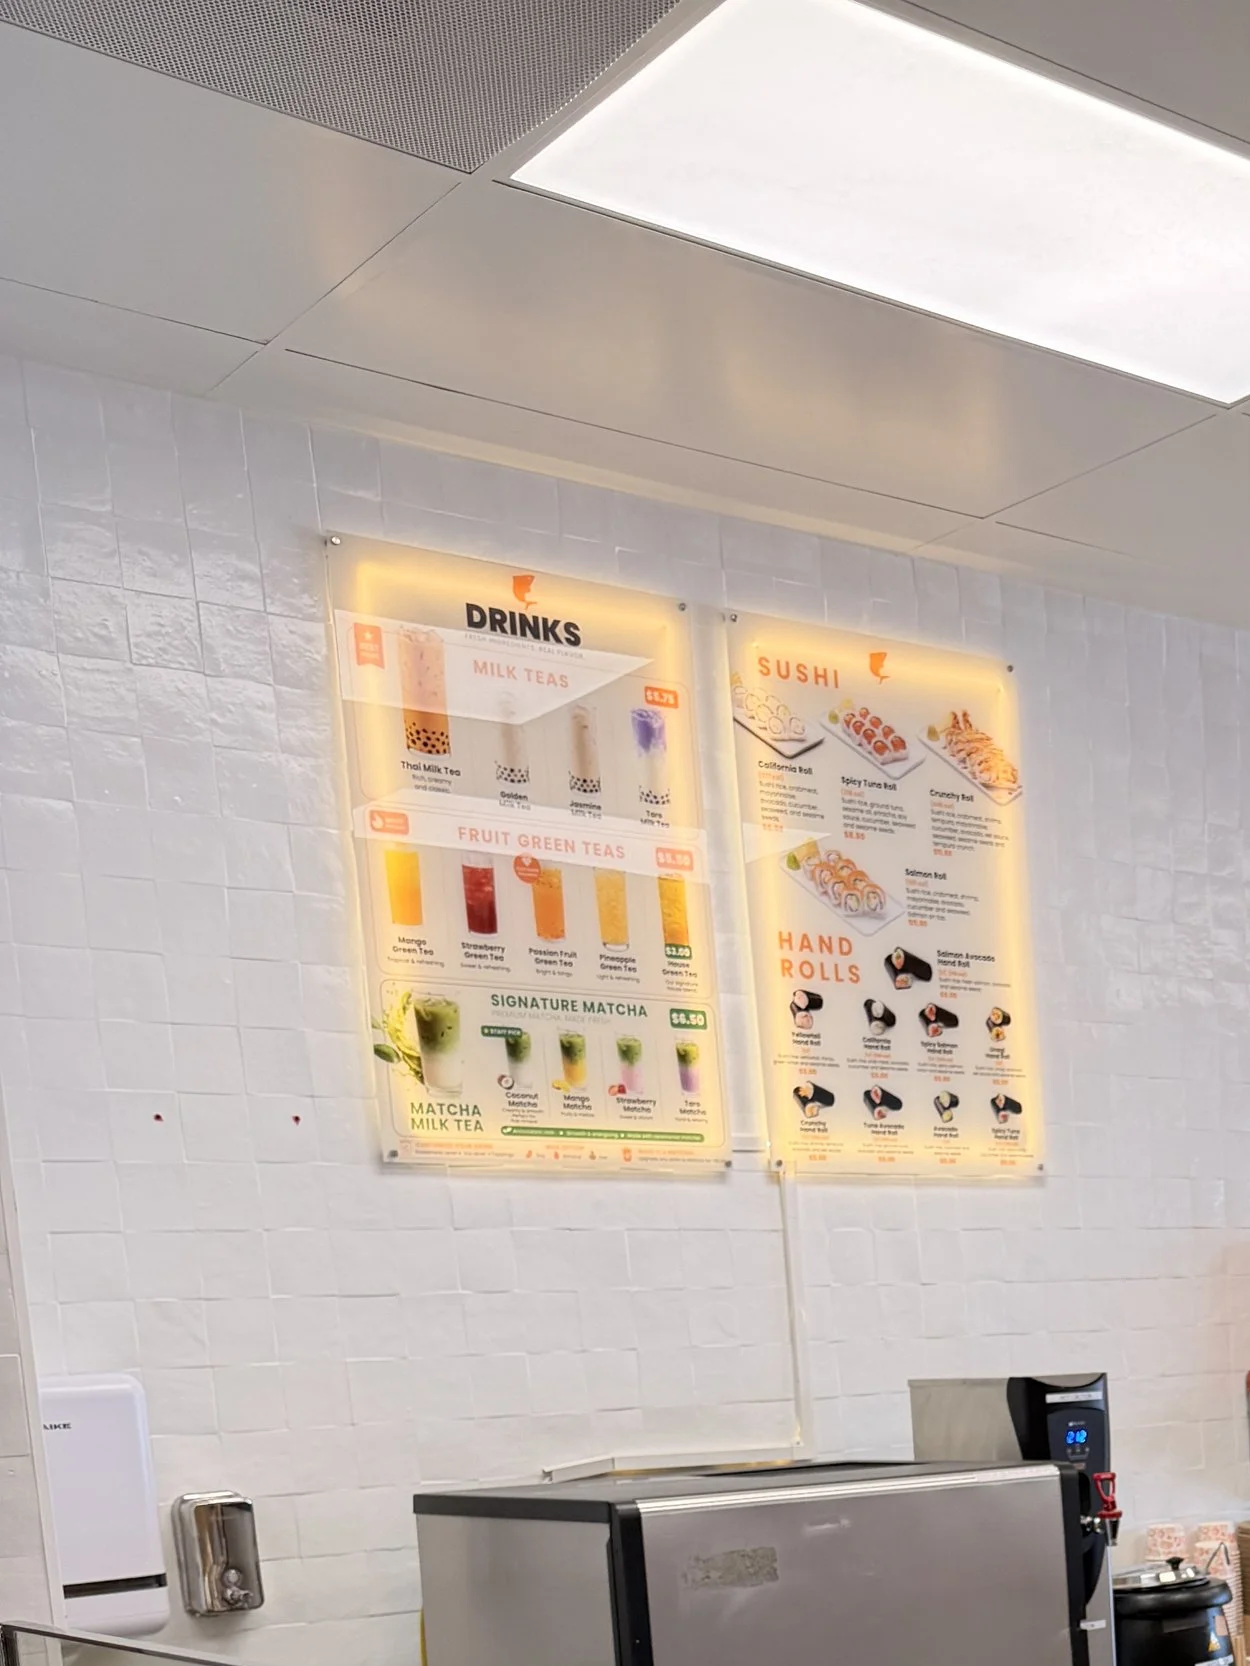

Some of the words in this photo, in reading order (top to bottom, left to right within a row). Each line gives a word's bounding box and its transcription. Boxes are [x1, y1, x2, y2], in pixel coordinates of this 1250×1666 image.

[465, 602, 581, 647] DRINKS
[473, 659, 518, 680] MILK
[524, 668, 569, 689] TEAS
[757, 655, 840, 690] SUSHI
[400, 760, 422, 771] Thai
[423, 764, 443, 775] Milk
[444, 767, 461, 777] Tea
[758, 760, 797, 774] California
[798, 766, 813, 775] Roll
[841, 776, 862, 789] Spicy
[863, 779, 882, 790] Tuna
[883, 782, 897, 791] Roll
[500, 791, 529, 801] Golden
[929, 789, 960, 802] Crunchy
[961, 793, 974, 802] Roll
[569, 800, 602, 811] Jasmine
[458, 826, 511, 846] FRUIT
[517, 833, 576, 854] GREEN
[581, 841, 626, 860] TEAS
[905, 868, 933, 879] Salmon
[933, 871, 947, 880] Roll
[398, 936, 427, 948] Mango
[461, 941, 506, 954] Strawberry
[778, 930, 853, 956] HAND
[392, 945, 418, 955] Green
[419, 947, 434, 956] Tea
[528, 947, 559, 958] Passion
[559, 949, 578, 960] Fruit
[936, 950, 964, 959] Salmon
[965, 953, 996, 962] Avocado
[464, 951, 489, 961] Green
[489, 953, 504, 962] Tea
[599, 954, 637, 965] Pineapple
[534, 957, 558, 967] Green
[559, 959, 574, 968] Tea
[600, 963, 623, 973] Green
[624, 964, 638, 973] Tea
[937, 958, 957, 967] Hand
[957, 959, 971, 968] Roll
[661, 968, 684, 977] Green
[684, 969, 698, 979] Tea
[780, 958, 861, 984] ROLLS
[490, 993, 578, 1013] SIGNATURE
[582, 1000, 648, 1018] MATCHA
[671, 1012, 705, 1027] $6.50
[791, 1031, 821, 1040] Yellowtail
[862, 1036, 892, 1045] California
[792, 1038, 809, 1046] Hand
[937, 1041, 958, 1049] Salmon
[505, 1091, 539, 1101] Coconut
[563, 1094, 590, 1105] Mango
[616, 1096, 656, 1107] Strawberry
[410, 1102, 482, 1118] MATCHA
[508, 1100, 538, 1109] Matcha
[563, 1102, 592, 1112] Matcha
[623, 1105, 651, 1114] Matcha
[679, 1107, 707, 1116] Matcha
[410, 1117, 449, 1132] MILK
[454, 1118, 484, 1132] TEA
